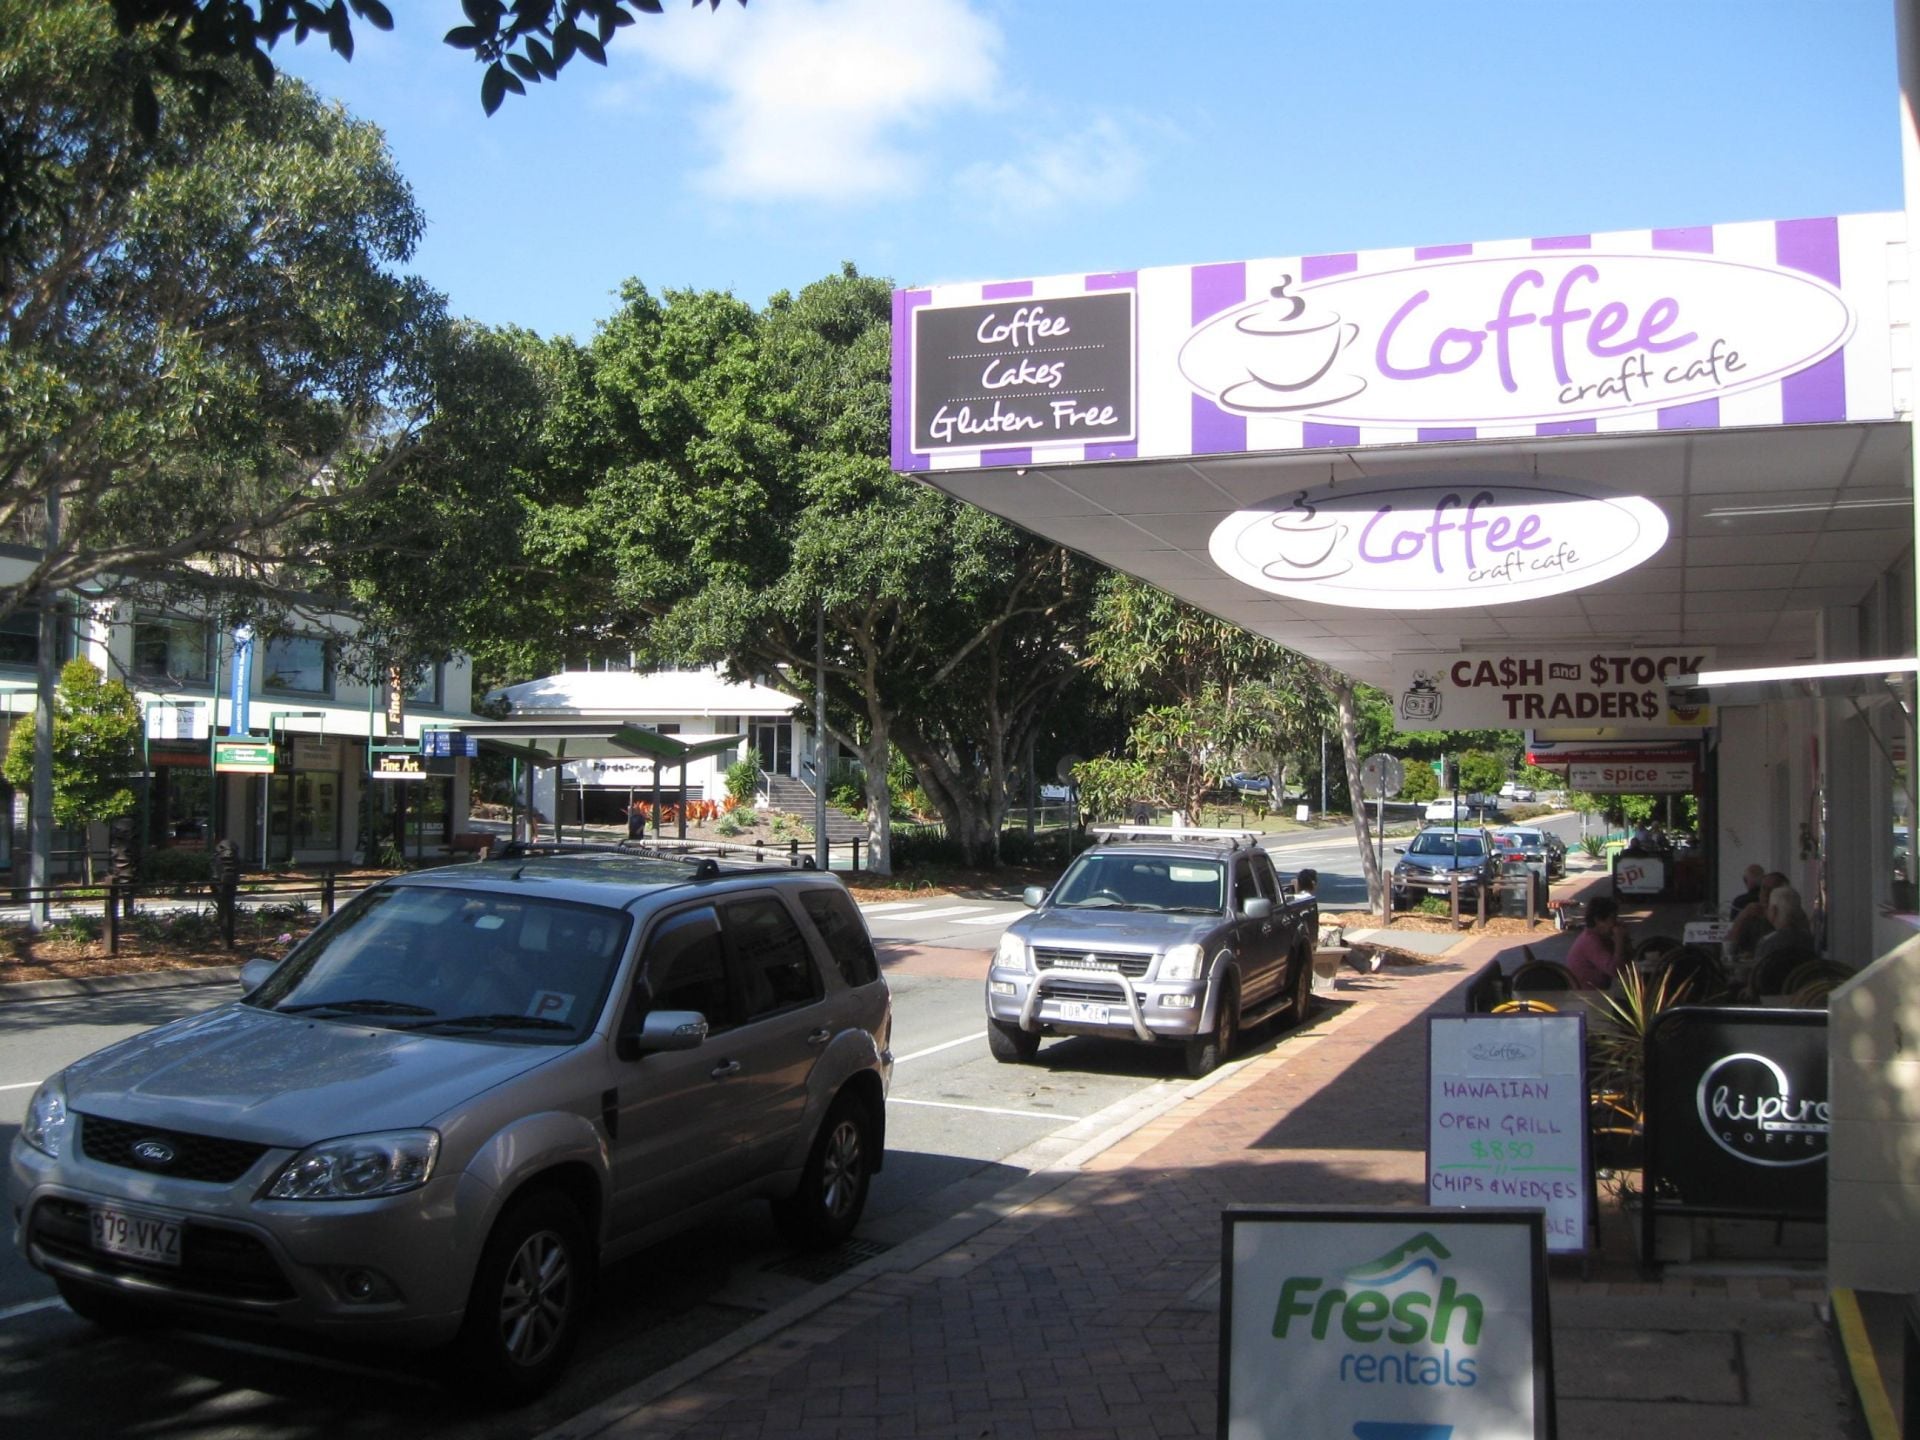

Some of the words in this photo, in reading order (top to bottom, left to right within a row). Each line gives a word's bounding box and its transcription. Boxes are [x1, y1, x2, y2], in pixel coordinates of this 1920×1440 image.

[976, 306, 1070, 347] Coffee
[1375, 264, 1698, 393] Coffee
[981, 358, 1065, 389] Cakes
[1558, 354, 1654, 405] craft
[1663, 338, 1747, 386] cafe
[929, 401, 1043, 443] Gluten
[1049, 400, 1118, 429] Free
[1357, 491, 1552, 574] Coffee
[1468, 549, 1525, 583] craft
[1530, 542, 1580, 575] cafe
[1551, 664, 1579, 679] and
[388, 692, 401, 724] Fine
[380, 758, 401, 772] Fine
[402, 758, 419, 772] Art
[1602, 765, 1658, 784] spice
[534, 993, 564, 1016] P
[1443, 1081, 1549, 1099] HAWAIIAN
[1439, 1112, 1490, 1130] OPEN
[1501, 1115, 1561, 1136] GRILL
[1722, 1131, 1815, 1146] COFFE
[1432, 1173, 1484, 1193] CHIPS
[1502, 1179, 1577, 1201] WEDGES
[1271, 1276, 1484, 1346] Fresh
[1339, 1349, 1478, 1388] rentals
